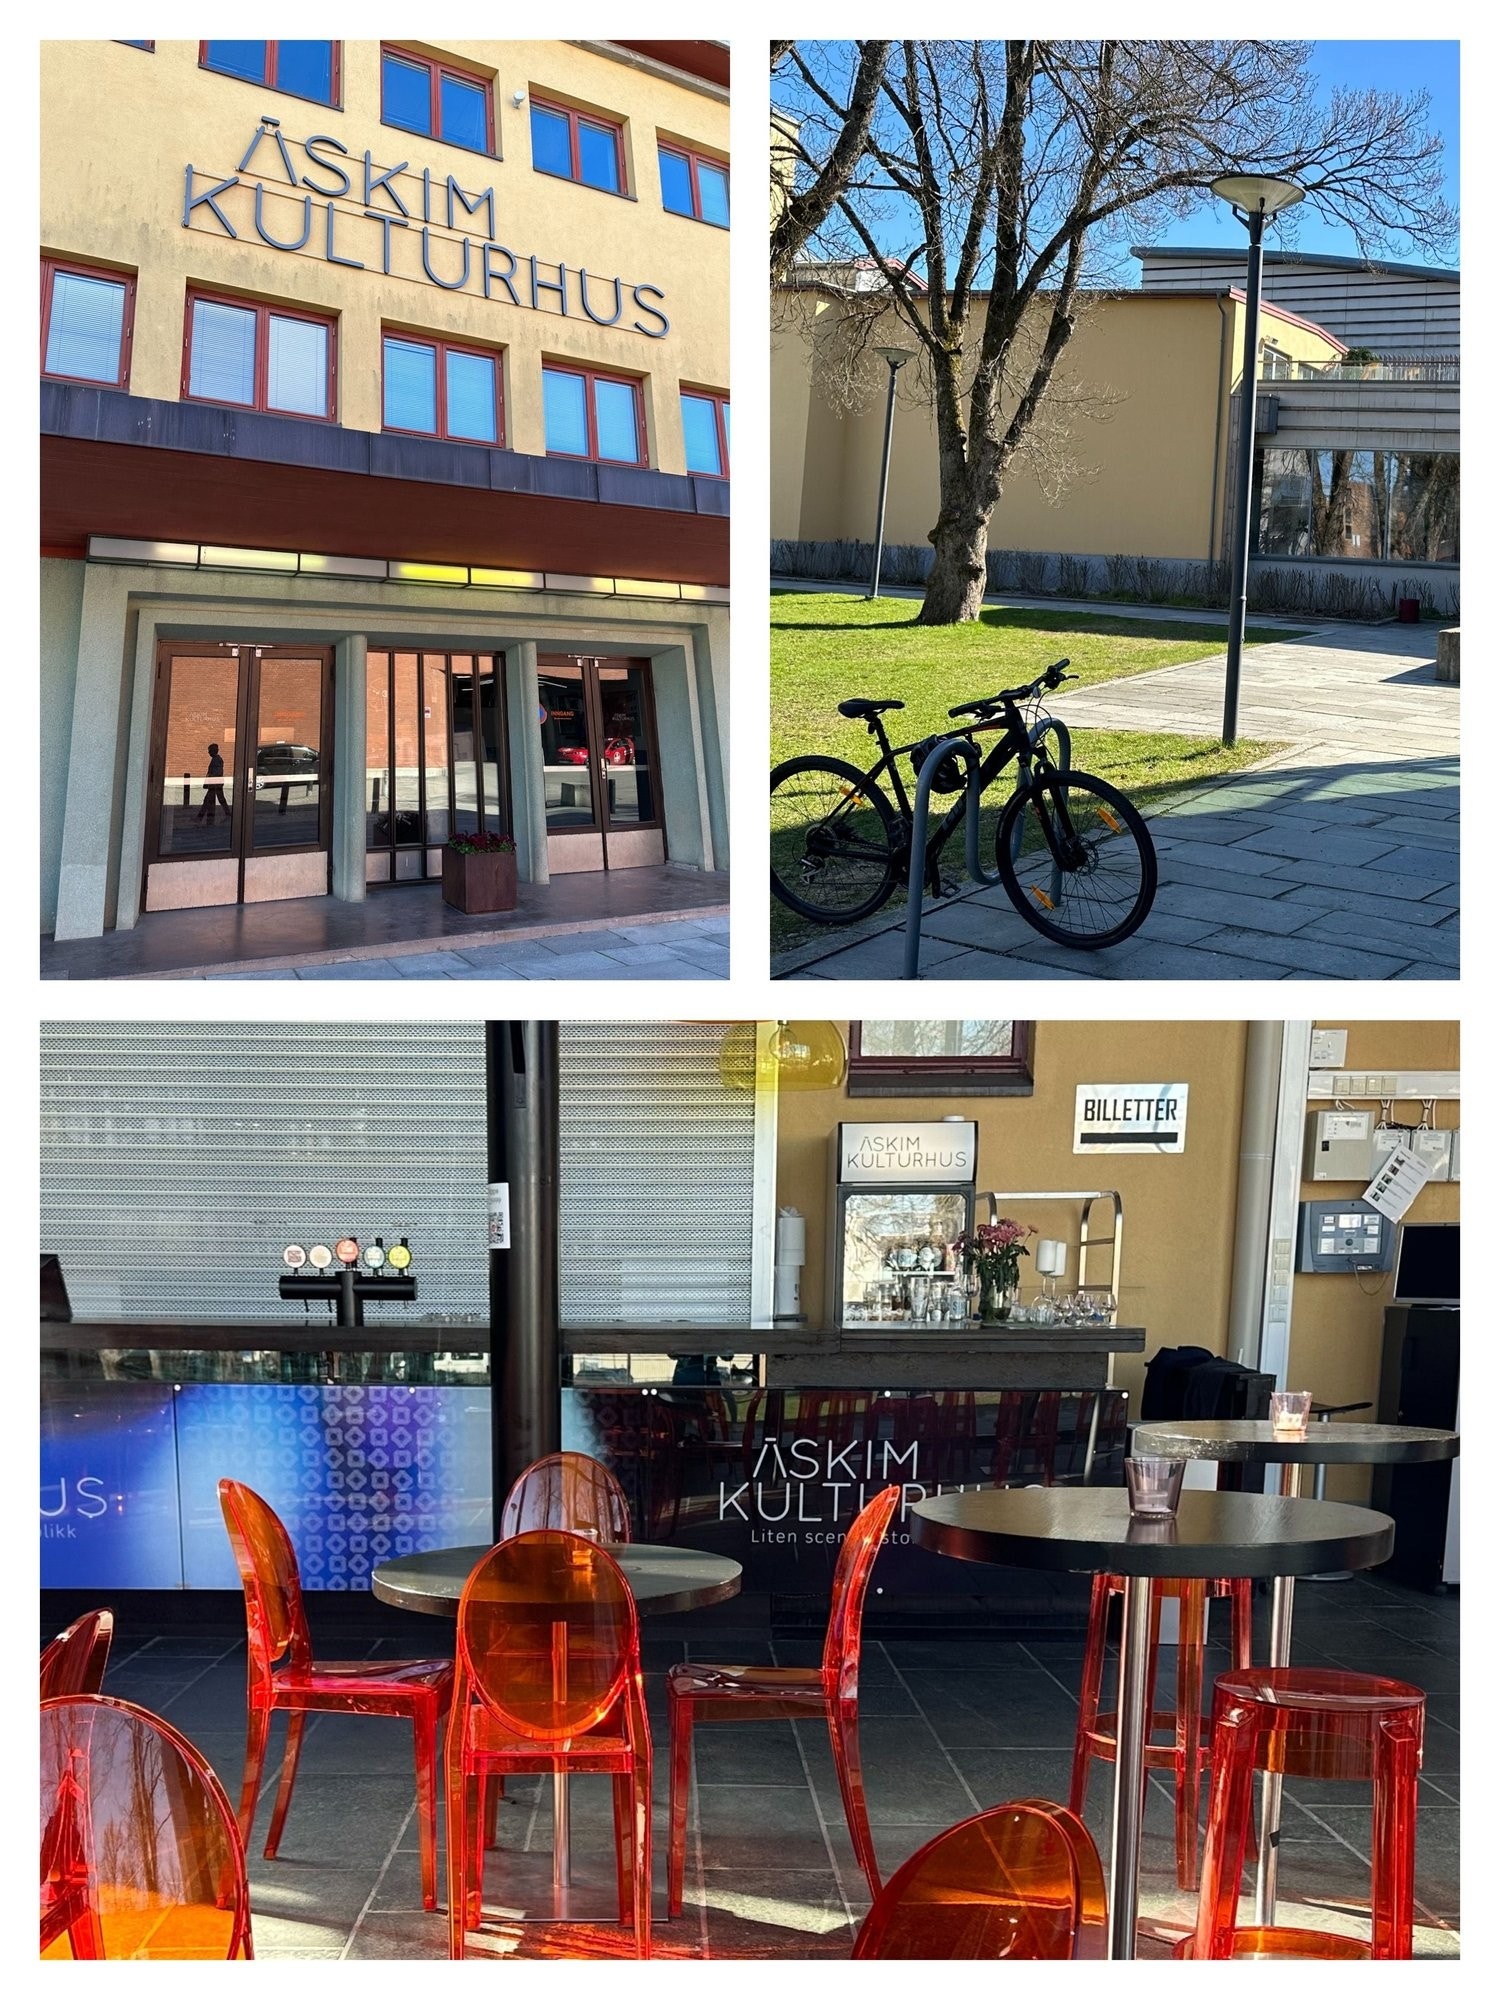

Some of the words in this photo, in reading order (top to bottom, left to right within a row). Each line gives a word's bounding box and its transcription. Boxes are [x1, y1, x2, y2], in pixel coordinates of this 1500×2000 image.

[181, 162, 671, 339] KULTURHUS
[1083, 1099, 1178, 1121] BILLETTER
[847, 1151, 967, 1168] KULTURHUS
[40, 1524, 77, 1538] likk
[751, 1528, 797, 1544] Liten
[805, 1532, 847, 1544] scen
[881, 1530, 915, 1545] sto
